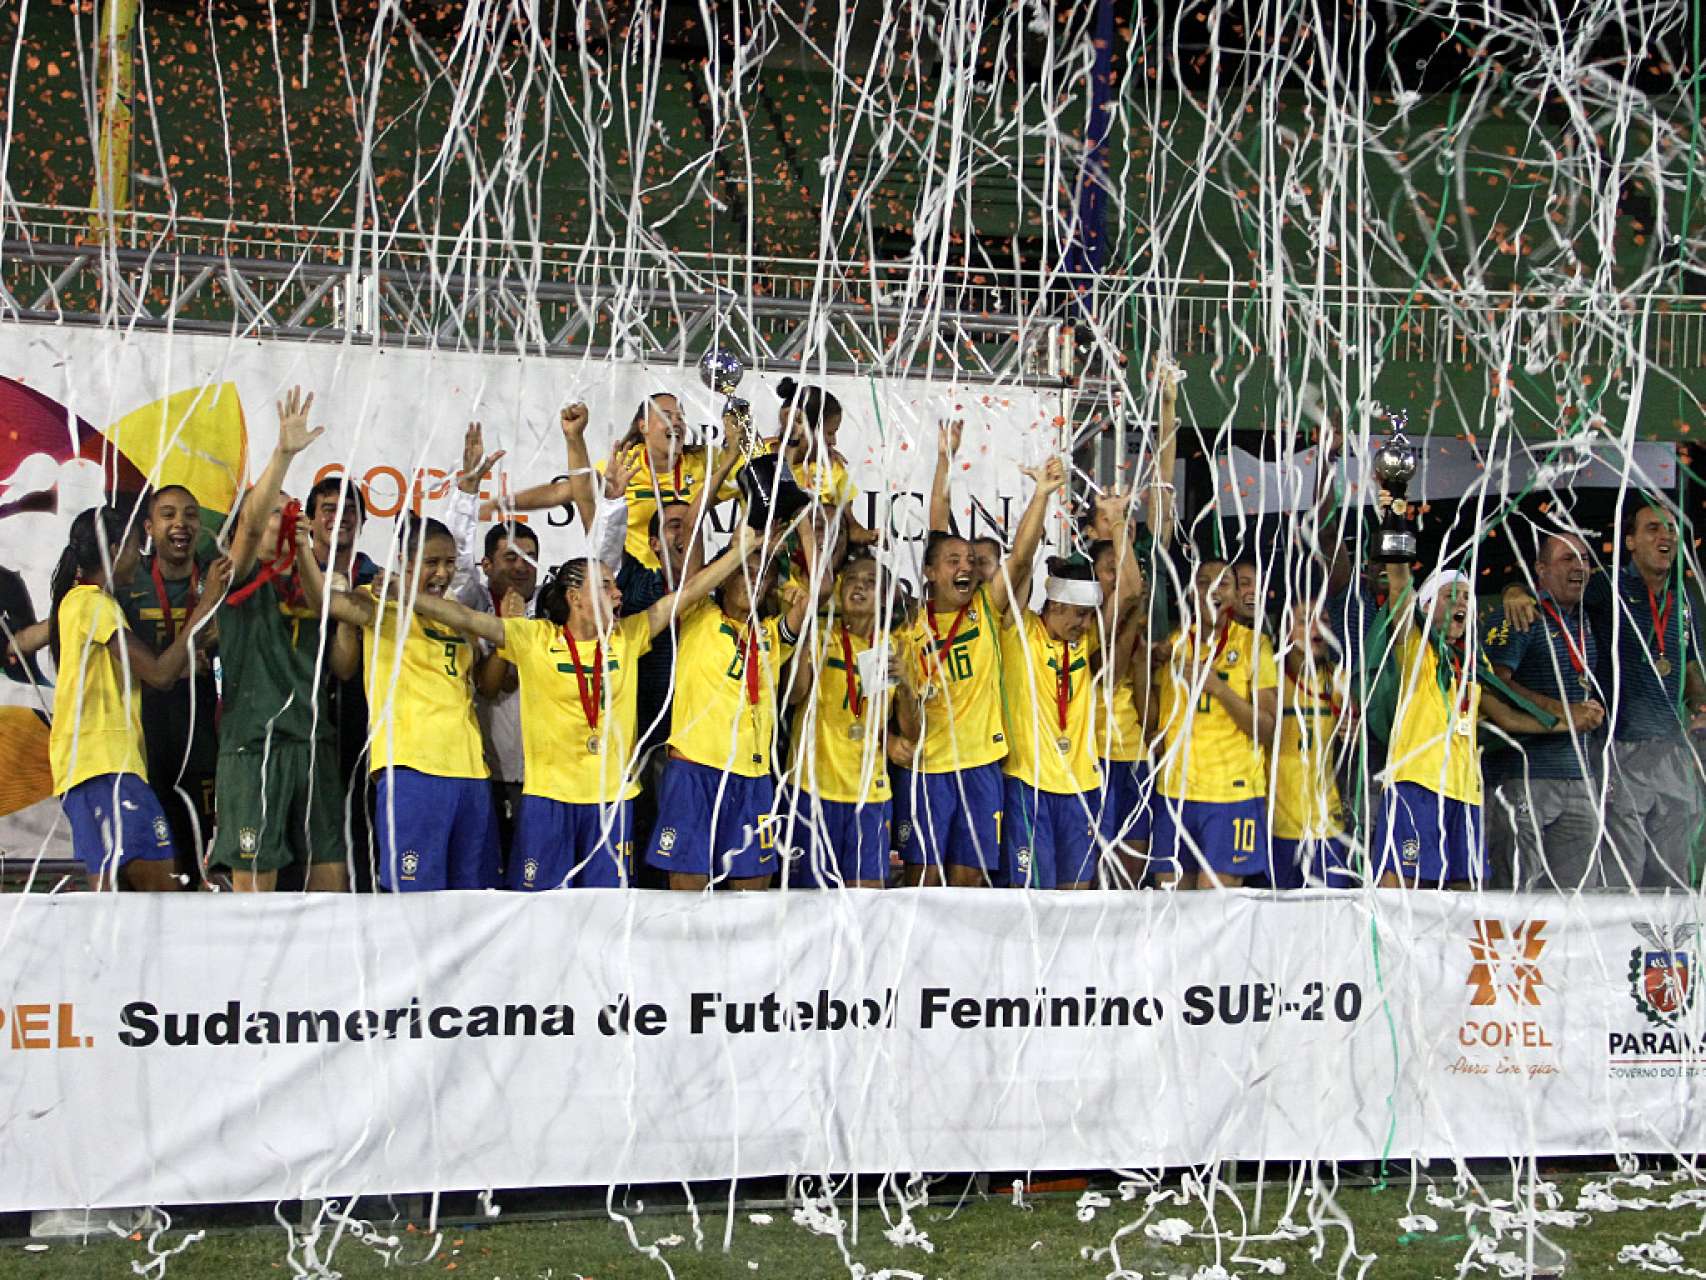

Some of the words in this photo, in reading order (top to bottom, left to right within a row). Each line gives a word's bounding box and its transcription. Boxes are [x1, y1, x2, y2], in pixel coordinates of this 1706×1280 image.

[445, 642, 457, 676] 9
[948, 644, 974, 682] 16
[1232, 818, 1256, 852] 10
[0, 1003, 94, 1050] EL.
[117, 998, 575, 1048] Sudamericana
[597, 993, 667, 1036] de
[690, 987, 899, 1035] Futebol
[920, 987, 1164, 1029] Feminino
[1182, 982, 1363, 1026] SUB-20
[1458, 1021, 1552, 1048] COPEL
[1609, 1032, 1706, 1055] PARAN
[1496, 1055, 1561, 1081] Enegia
